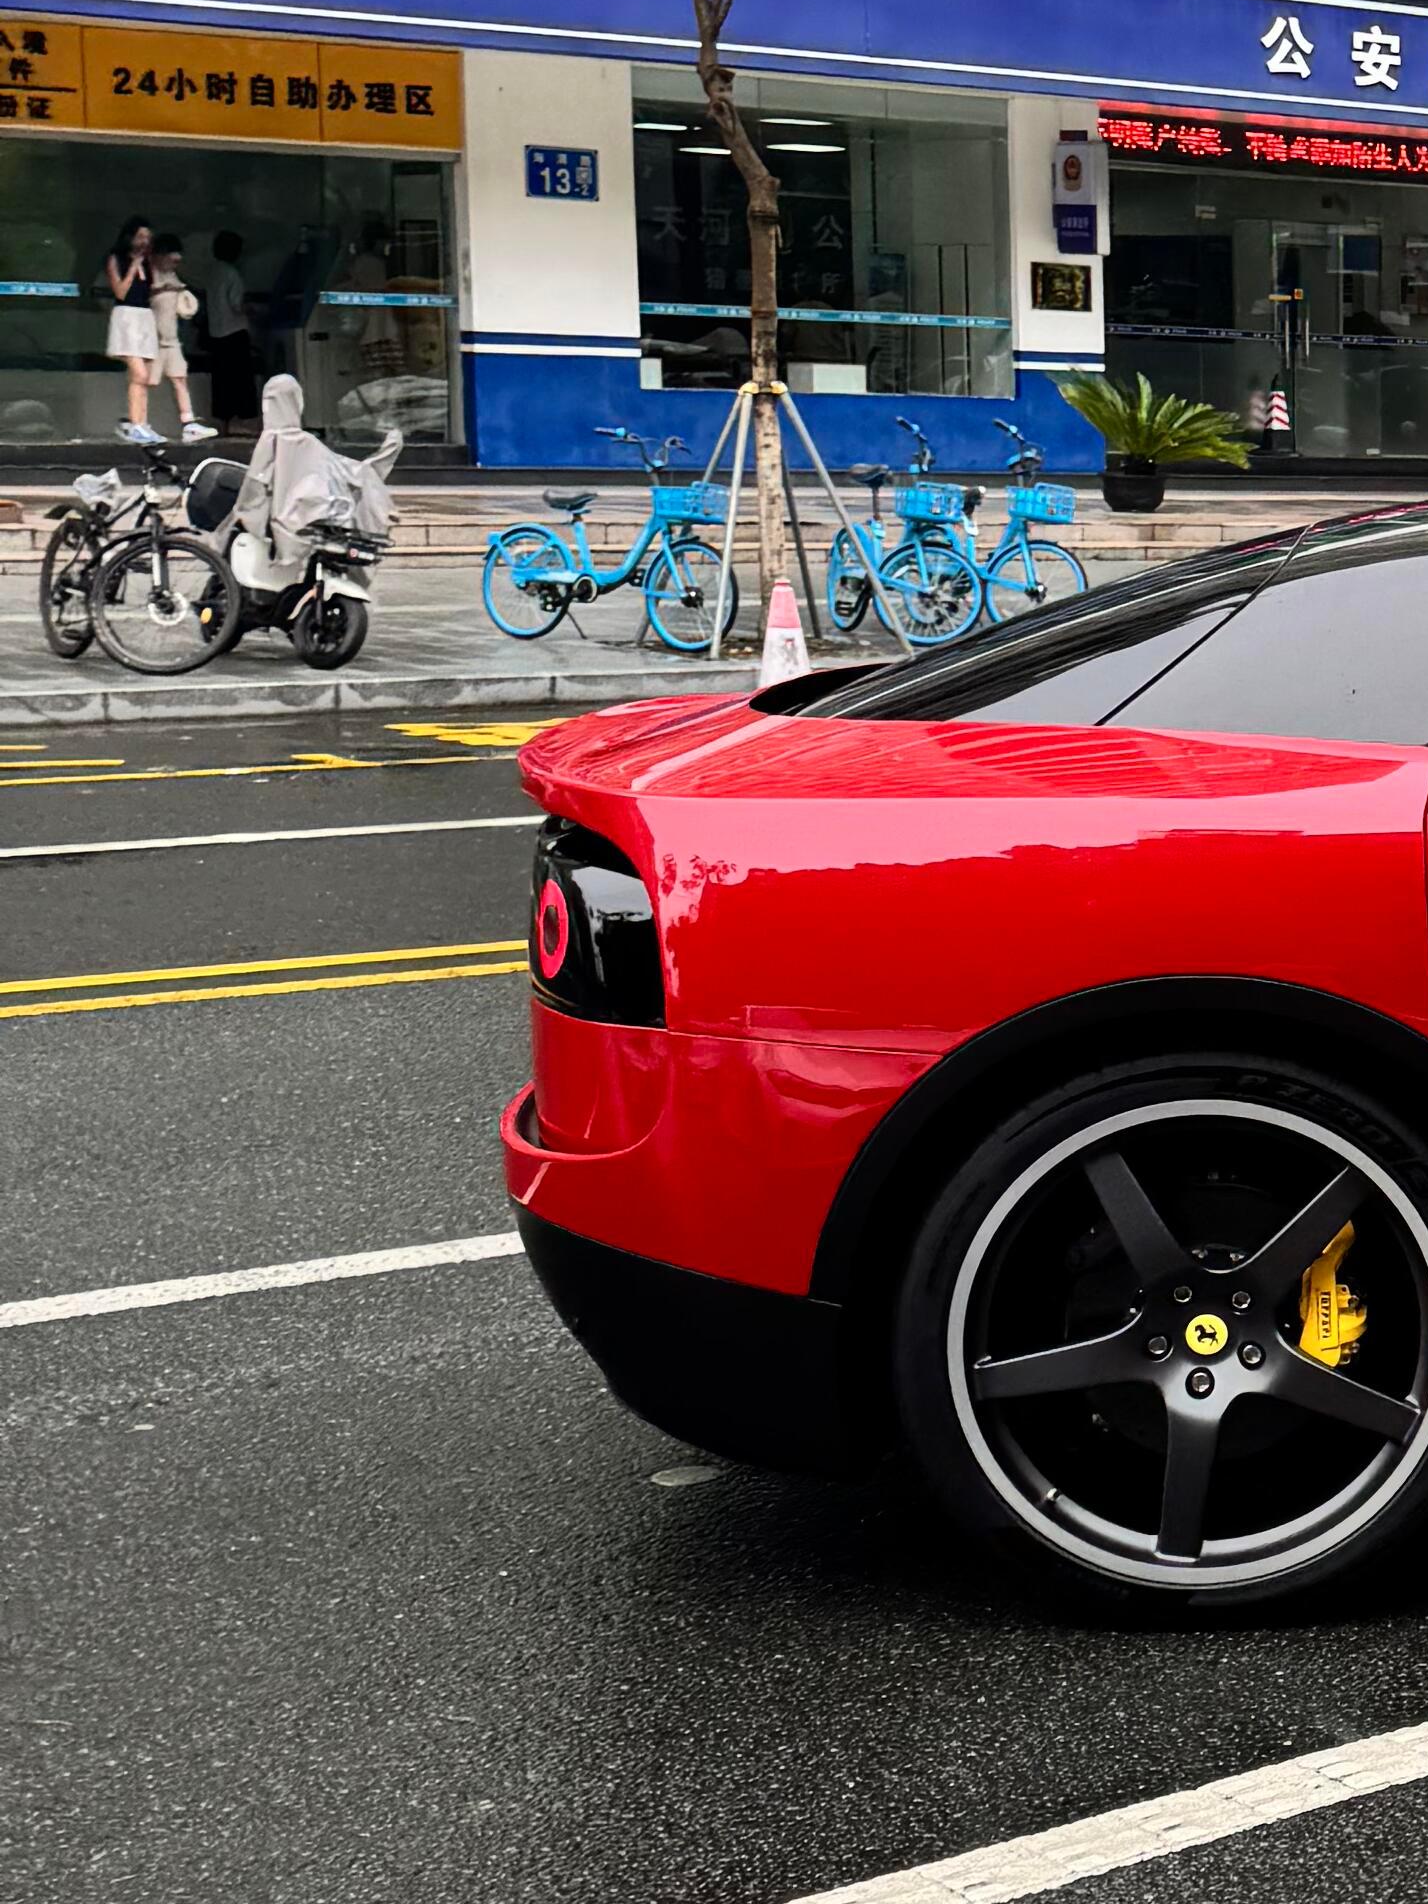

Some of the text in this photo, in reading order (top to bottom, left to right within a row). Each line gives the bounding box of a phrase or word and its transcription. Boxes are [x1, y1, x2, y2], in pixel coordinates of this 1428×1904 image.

[1260, 16, 1401, 91] 公安
[113, 67, 435, 117] 24小时自助办理区
